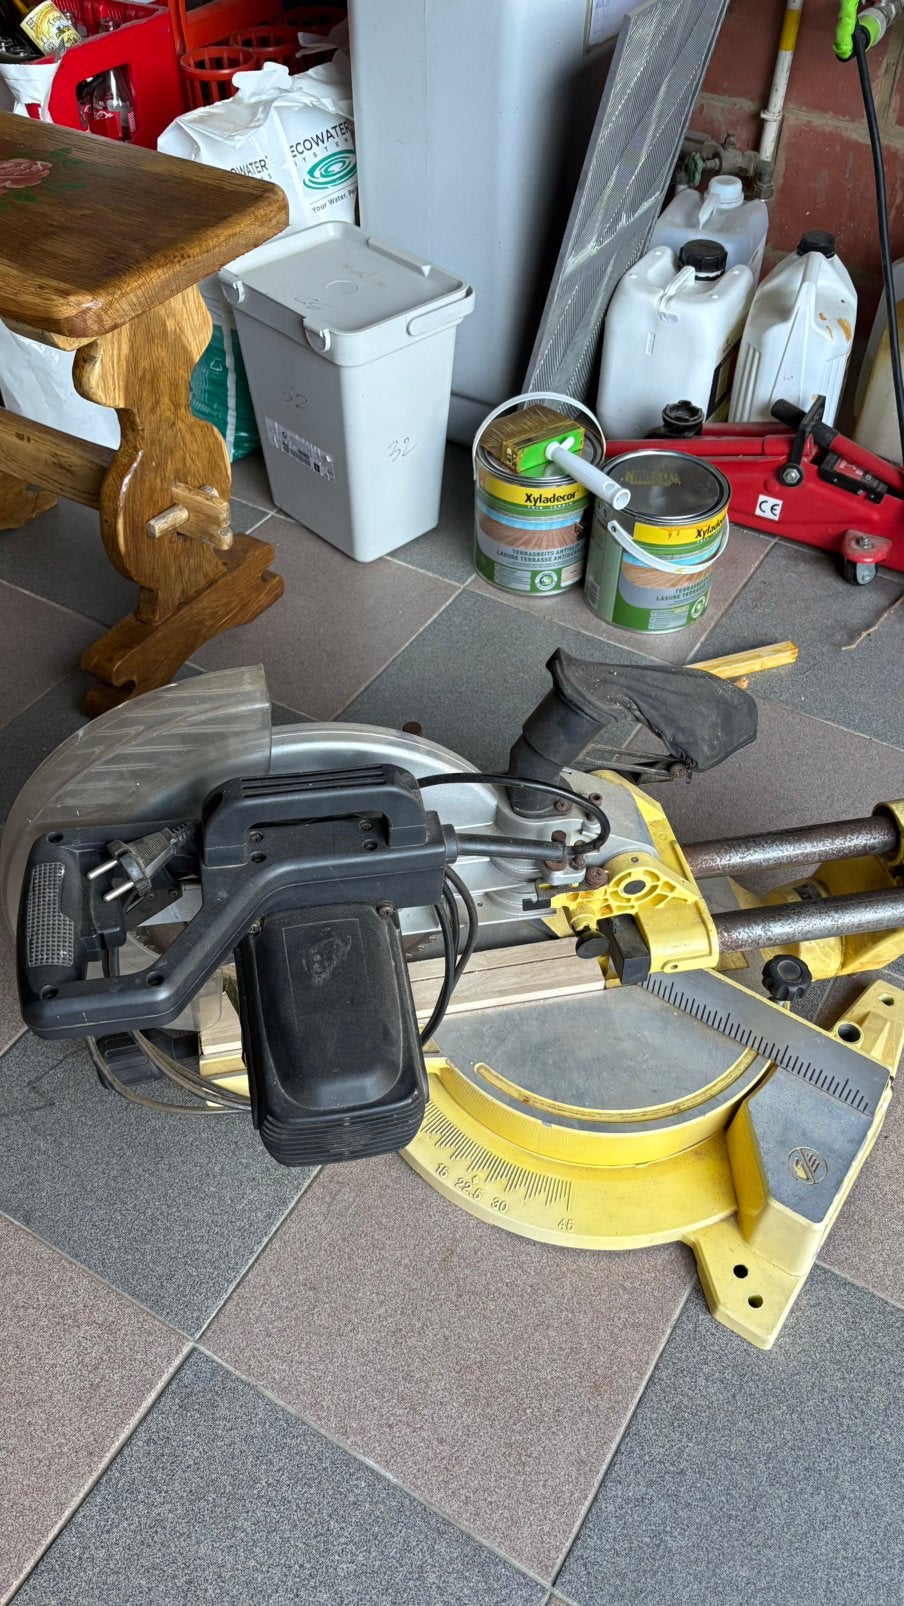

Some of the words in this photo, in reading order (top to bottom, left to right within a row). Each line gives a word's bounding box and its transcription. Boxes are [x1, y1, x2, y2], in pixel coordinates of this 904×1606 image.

[289, 121, 351, 158] ECOWATER
[312, 203, 327, 213] Your
[280, 384, 308, 409] 32
[388, 437, 418, 462] 32
[525, 491, 577, 506] Xyladecor
[758, 500, 780, 517] CE
[454, 1177, 484, 1200] 22.5
[490, 1196, 509, 1213] 30
[557, 1217, 576, 1233] 45
